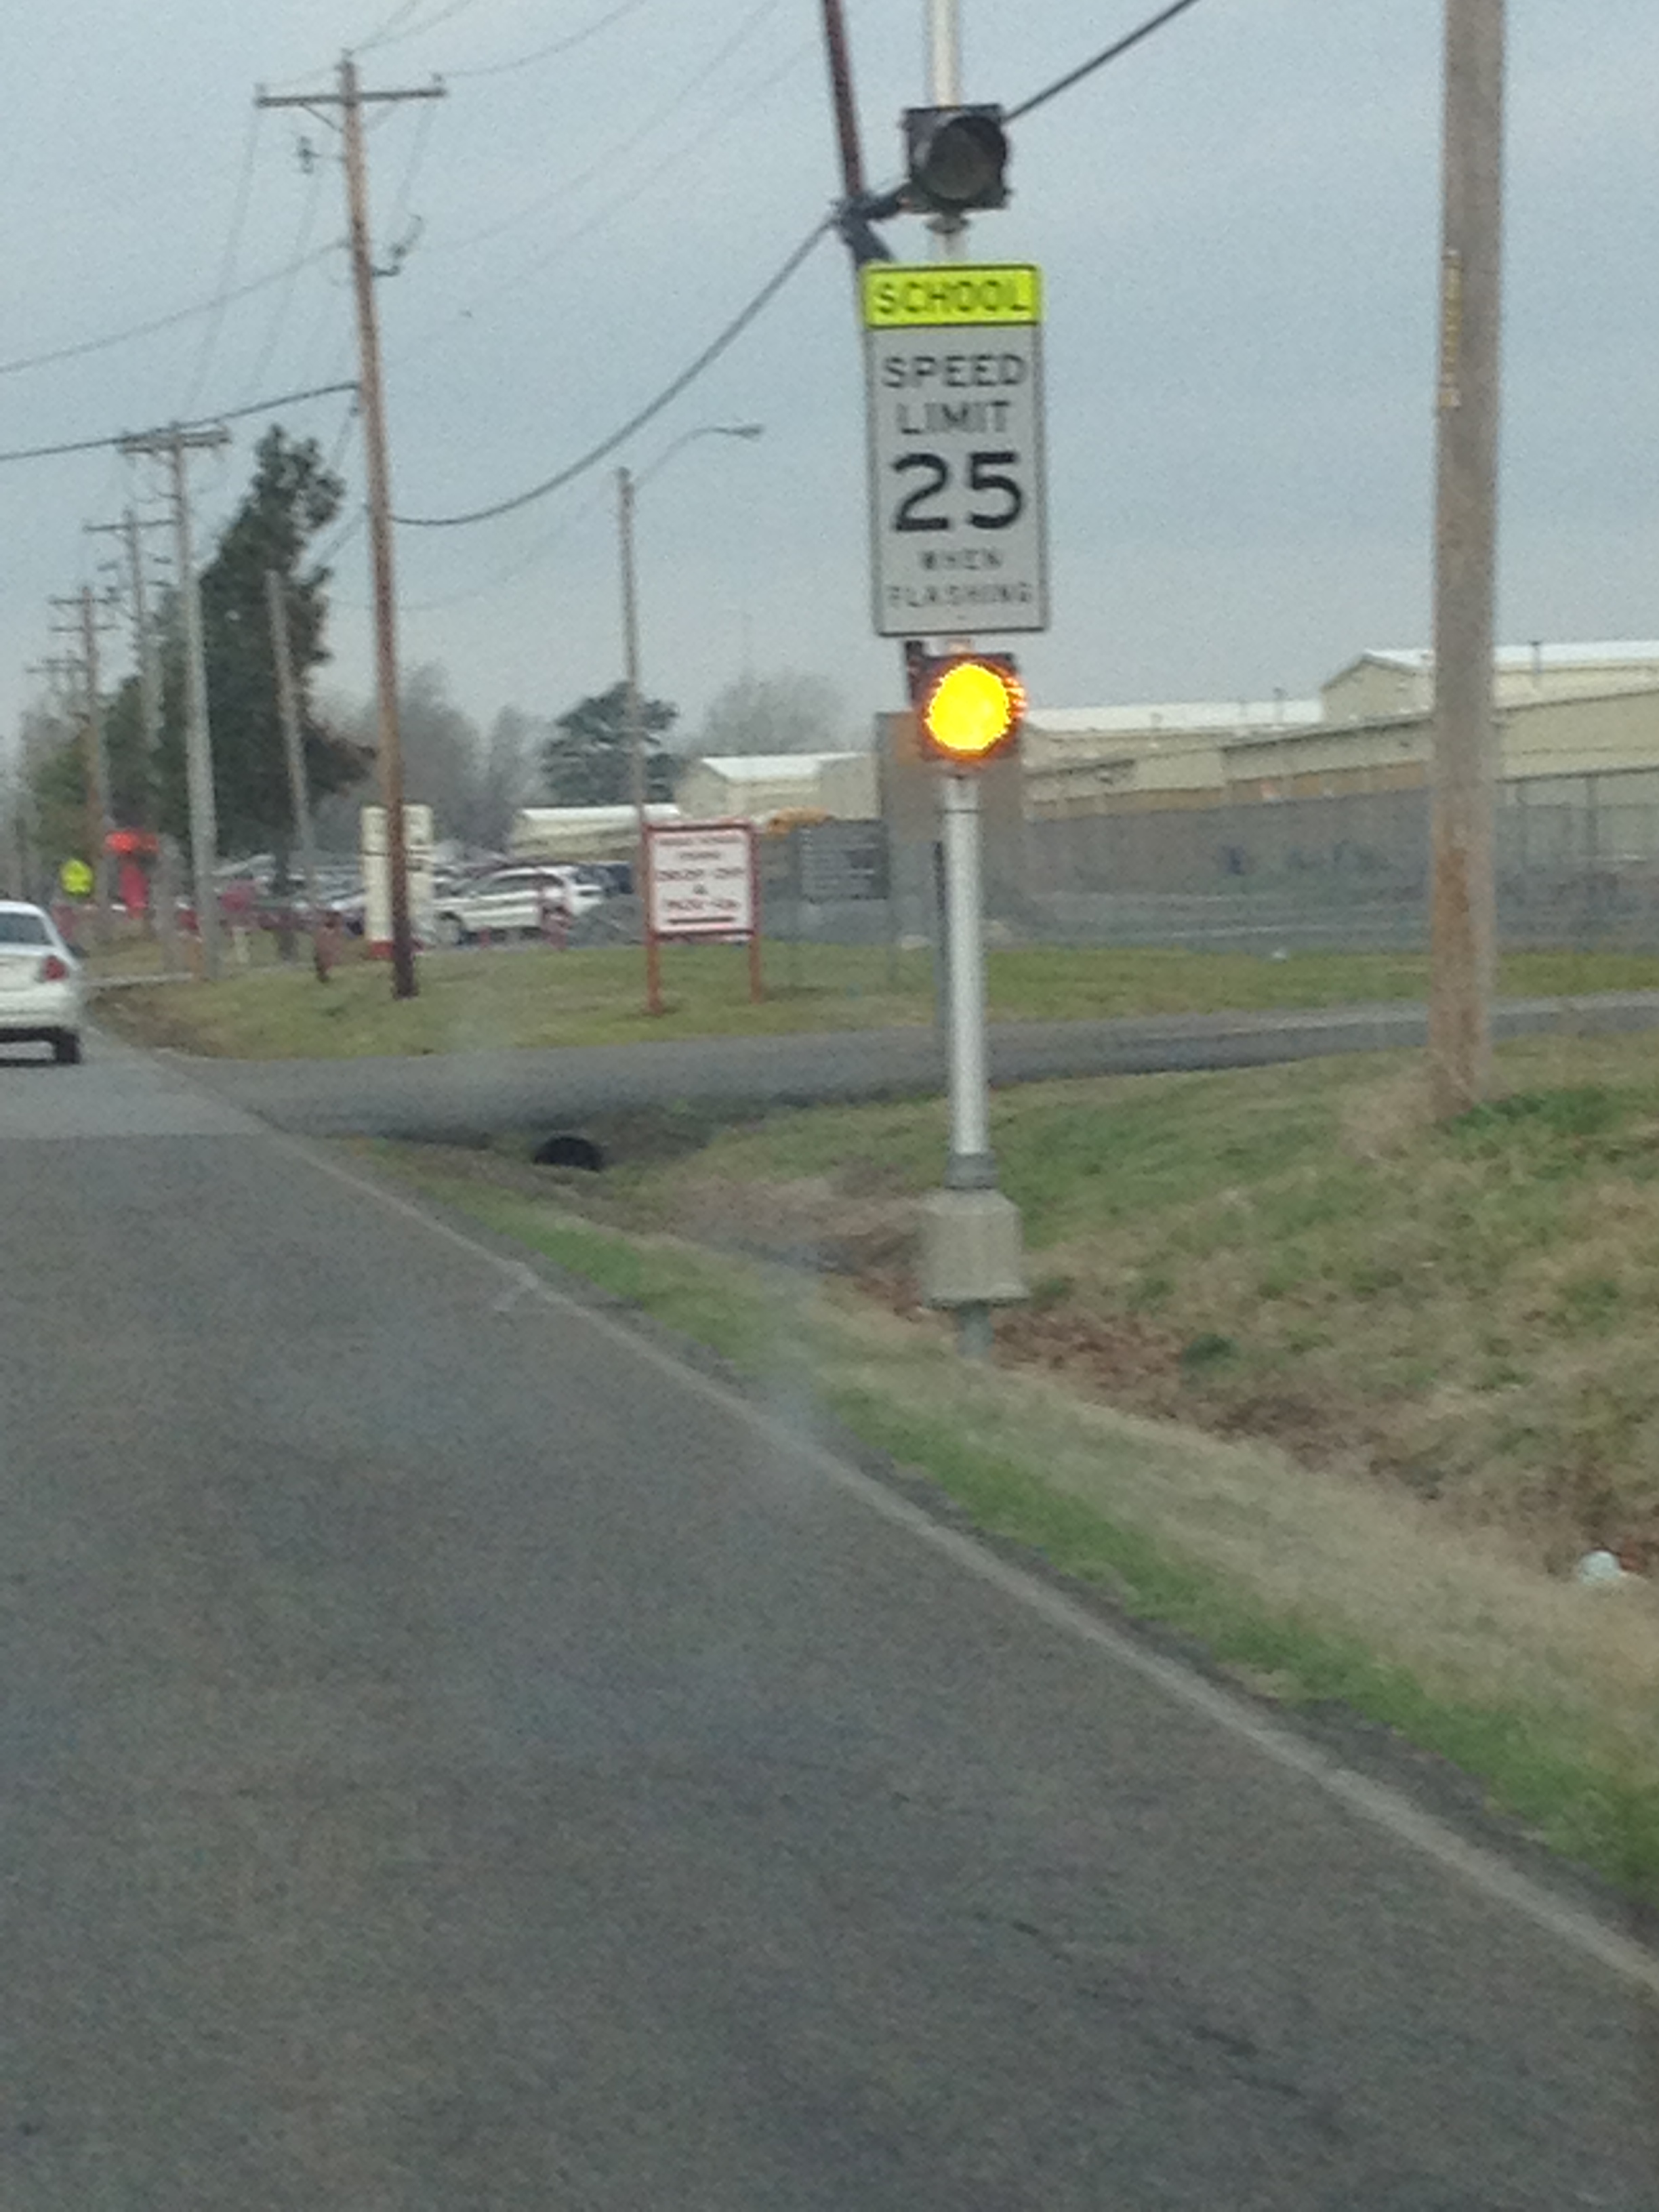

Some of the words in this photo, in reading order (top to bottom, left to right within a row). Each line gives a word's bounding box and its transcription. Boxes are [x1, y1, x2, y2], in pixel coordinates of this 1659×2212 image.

[876, 280, 1028, 314] SCHOOL
[884, 354, 1025, 388] SPEED
[897, 399, 1010, 434] LIMIT
[892, 451, 1022, 532] 25
[920, 548, 1001, 571] WHEN
[886, 581, 1031, 608] FLASHING
